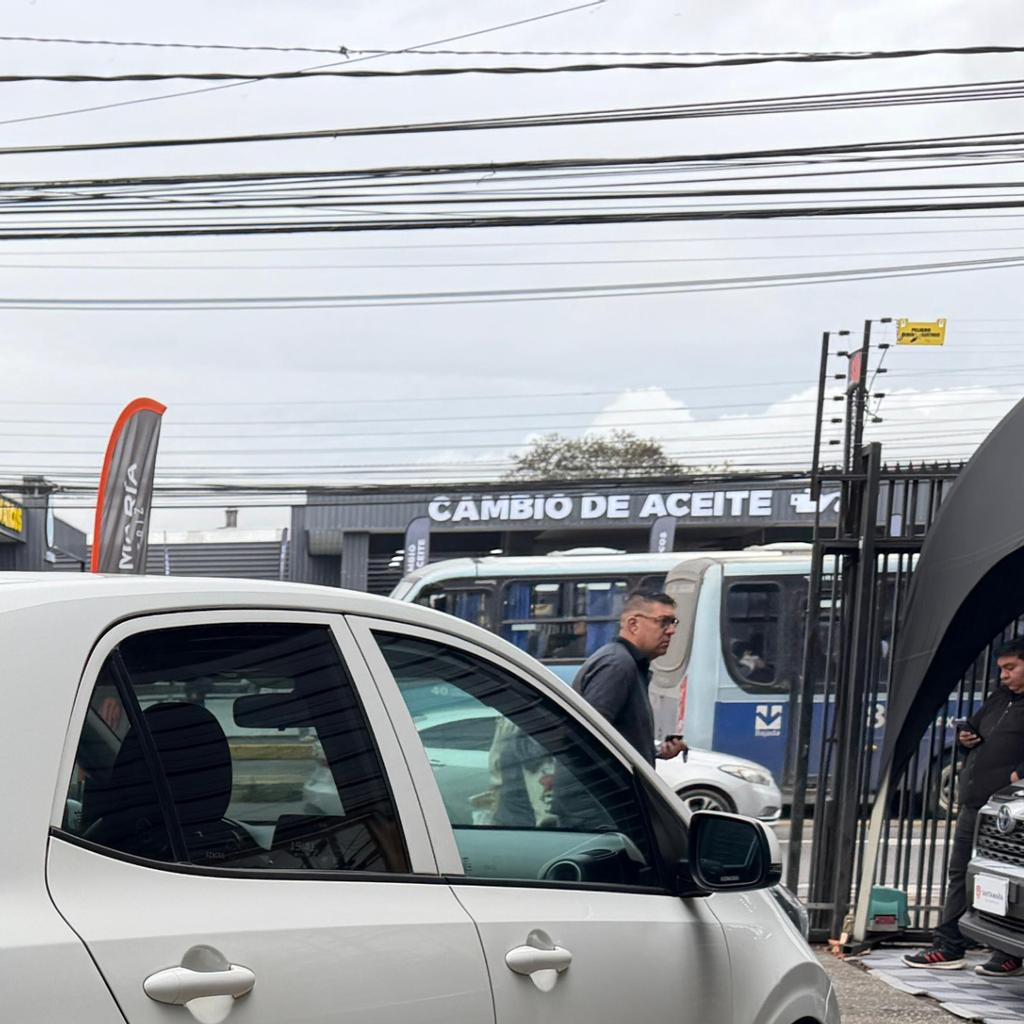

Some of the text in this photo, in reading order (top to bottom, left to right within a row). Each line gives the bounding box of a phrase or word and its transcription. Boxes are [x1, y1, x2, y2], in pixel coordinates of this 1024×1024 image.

[428, 490, 773, 522] CAMBIO DE ACEITE
